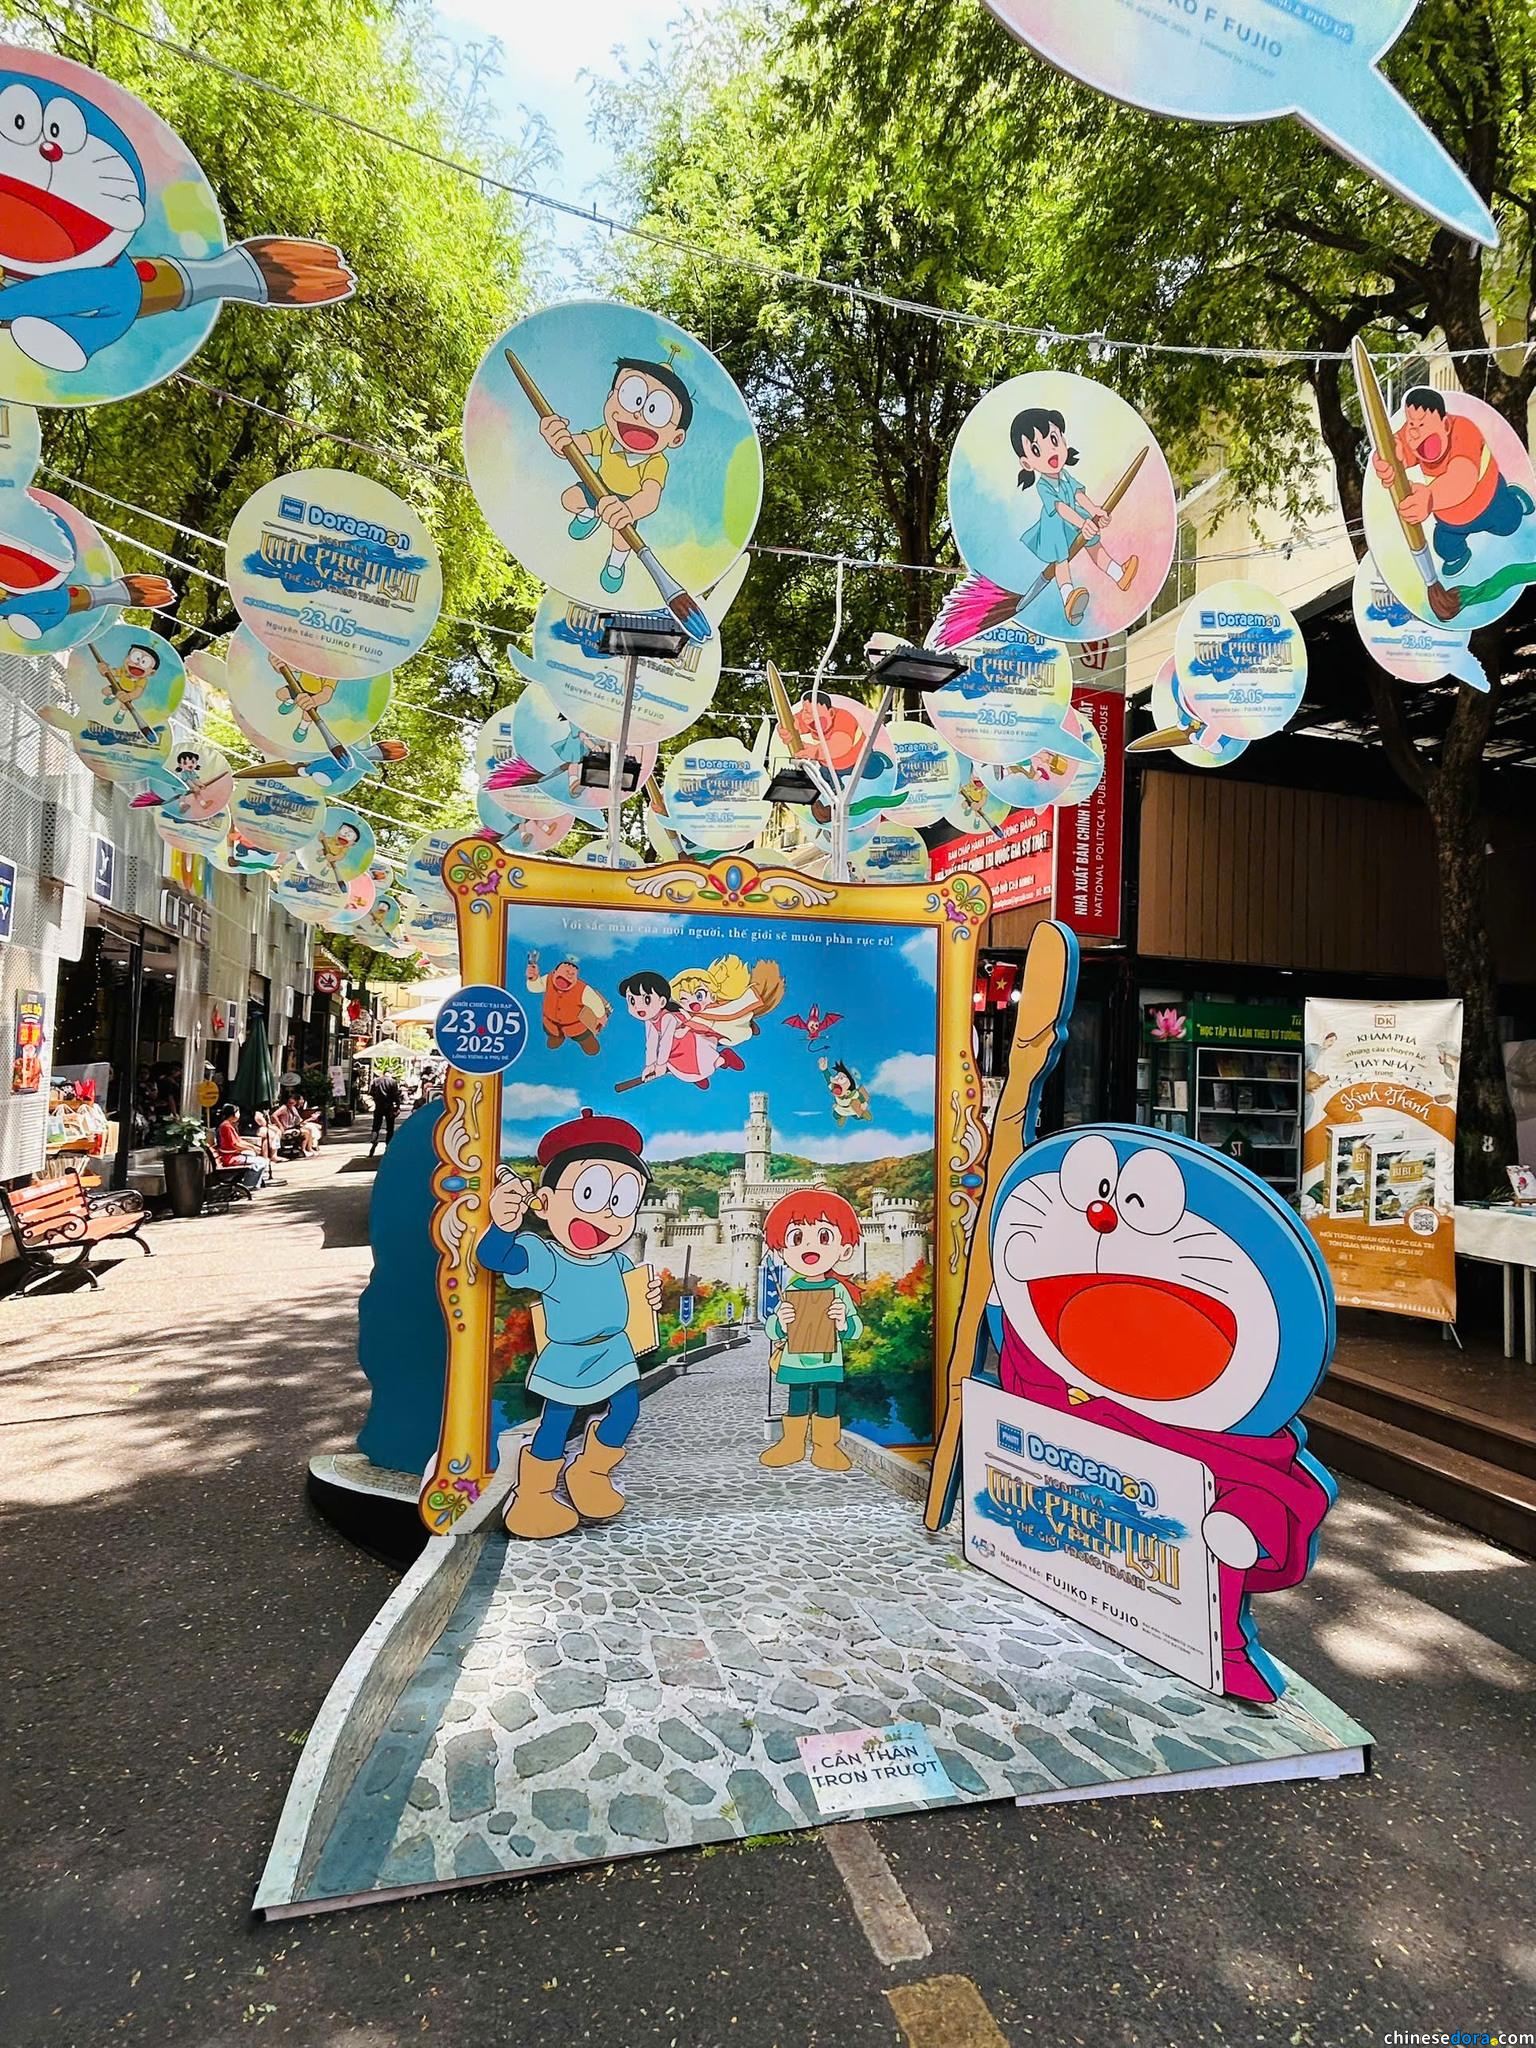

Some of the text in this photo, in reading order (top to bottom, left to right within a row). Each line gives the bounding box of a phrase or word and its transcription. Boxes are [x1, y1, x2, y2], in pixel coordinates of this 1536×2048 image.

[1203, 7, 1218, 23] F
[1223, 16, 1283, 58] FUJIO
[308, 504, 412, 552] Doraemon
[300, 606, 356, 637] 23.05
[1218, 612, 1281, 628] Doraemon
[1229, 688, 1264, 704] 23.05
[978, 709, 1018, 726] 23.05
[699, 758, 750, 770] Doraemon
[1094, 704, 1109, 917] NATIONAL POLITICAL HOUSE
[1075, 809, 1091, 841] CHÍNH
[1031, 829, 1048, 852] THẬT
[1073, 843, 1090, 864] BẢN
[1072, 865, 1089, 893] XUẤT
[1072, 895, 1088, 916] NHÀ
[662, 924, 684, 936] mọi
[688, 925, 725, 940] người,
[728, 927, 747, 939] thế
[751, 927, 772, 941] giới
[775, 931, 787, 941] sẽ
[791, 932, 822, 943] muôn
[825, 932, 853, 947] phần
[856, 936, 875, 948] rực
[878, 935, 895, 946] rỡ!
[441, 1008, 521, 1036] 23.05
[456, 1035, 505, 1053] 2025
[1354, 1059, 1379, 1069] HAY
[1340, 1082, 1430, 1120] Kinh Thánh
[1230, 1141, 1243, 1157] ST
[1482, 1135, 1494, 1153] 8
[1392, 1166, 1420, 1177] BIBLE
[1027, 1432, 1158, 1510] Doraemon
[1043, 1474, 1088, 1502] NOBITA
[1016, 1519, 1146, 1592] THẾ GIỚI TRONG TRANH
[1000, 1551, 1027, 1570] Nguyên
[1045, 1572, 1088, 1601] FUJIKO
[1091, 1595, 1098, 1606] F
[1102, 1602, 1139, 1628] FUJIO
[821, 1744, 919, 1769] CẨN THẬN
[812, 1760, 938, 1788] TRƠN TRƯỢT
